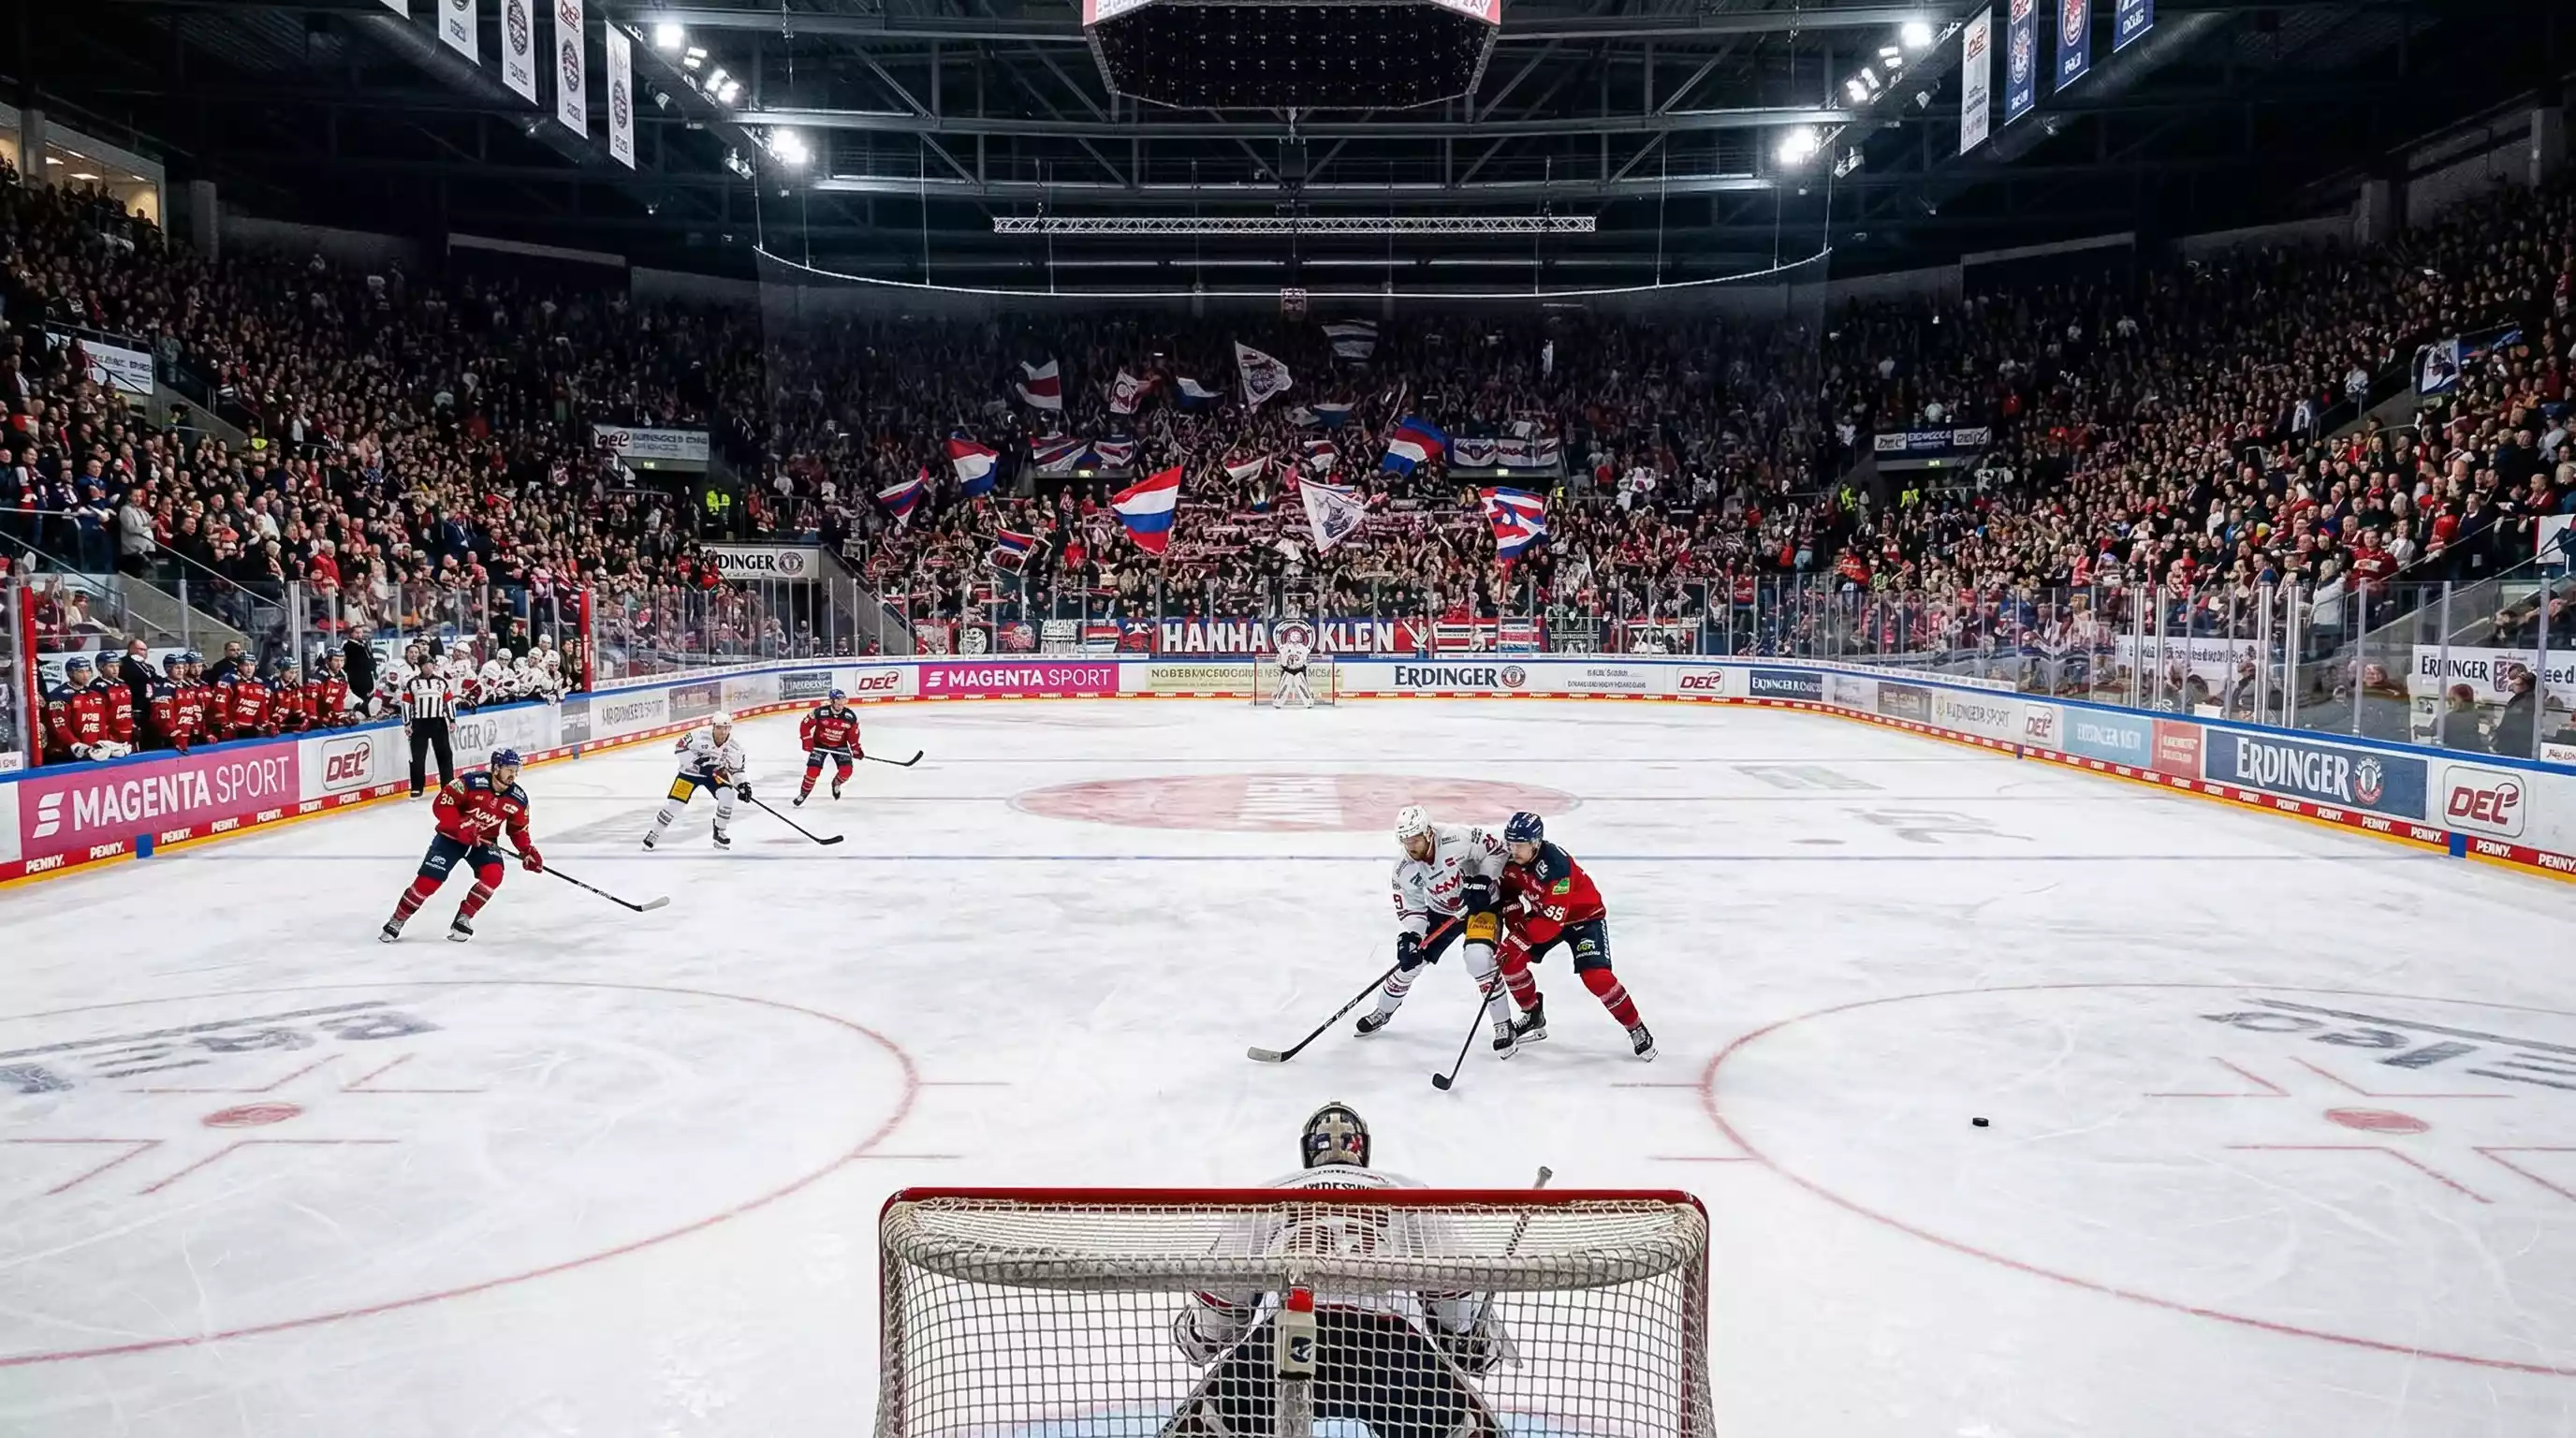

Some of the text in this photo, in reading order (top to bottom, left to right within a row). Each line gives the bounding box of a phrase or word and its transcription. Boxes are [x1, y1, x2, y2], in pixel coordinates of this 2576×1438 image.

[718, 554, 777, 571] DINGER
[858, 674, 897, 691] DEL
[948, 668, 1111, 687] MAGENTA SPORT
[1395, 666, 1500, 688] ERDINGER
[1680, 673, 1720, 689] DEL
[326, 745, 369, 783] DEL
[2235, 736, 2352, 803] ERDINGER
[72, 756, 290, 832] MAGENTA SPORT
[2447, 785, 2518, 826] DEL
